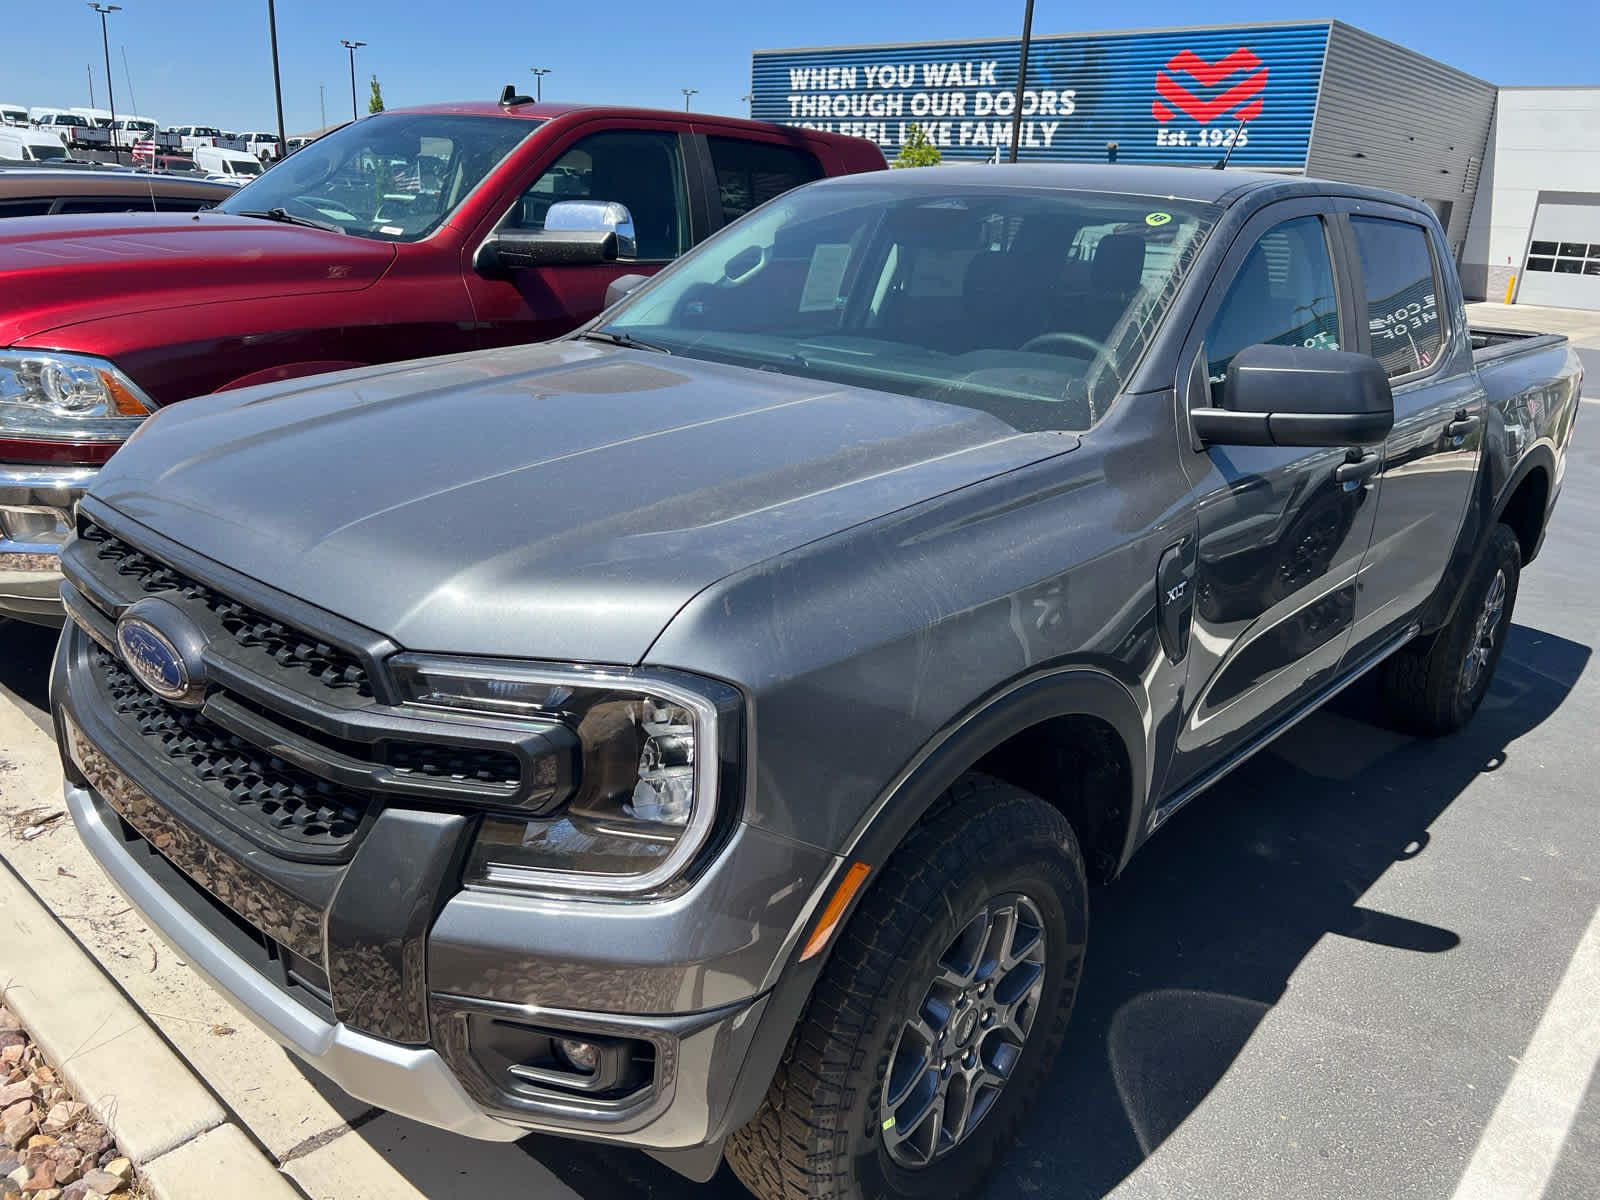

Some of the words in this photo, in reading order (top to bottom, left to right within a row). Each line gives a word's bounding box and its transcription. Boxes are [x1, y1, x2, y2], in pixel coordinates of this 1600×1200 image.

[789, 66, 857, 91] WHEN
[864, 64, 915, 89] YOU
[923, 60, 997, 87] WALK
[787, 93, 903, 117] THROUGH
[910, 91, 966, 116] OUR
[974, 89, 1076, 116] DOORS
[959, 121, 1060, 148] FAMILY
[1156, 128, 1191, 146] Est.
[1197, 128, 1248, 147] 1925
[1165, 581, 1188, 606] XLT
